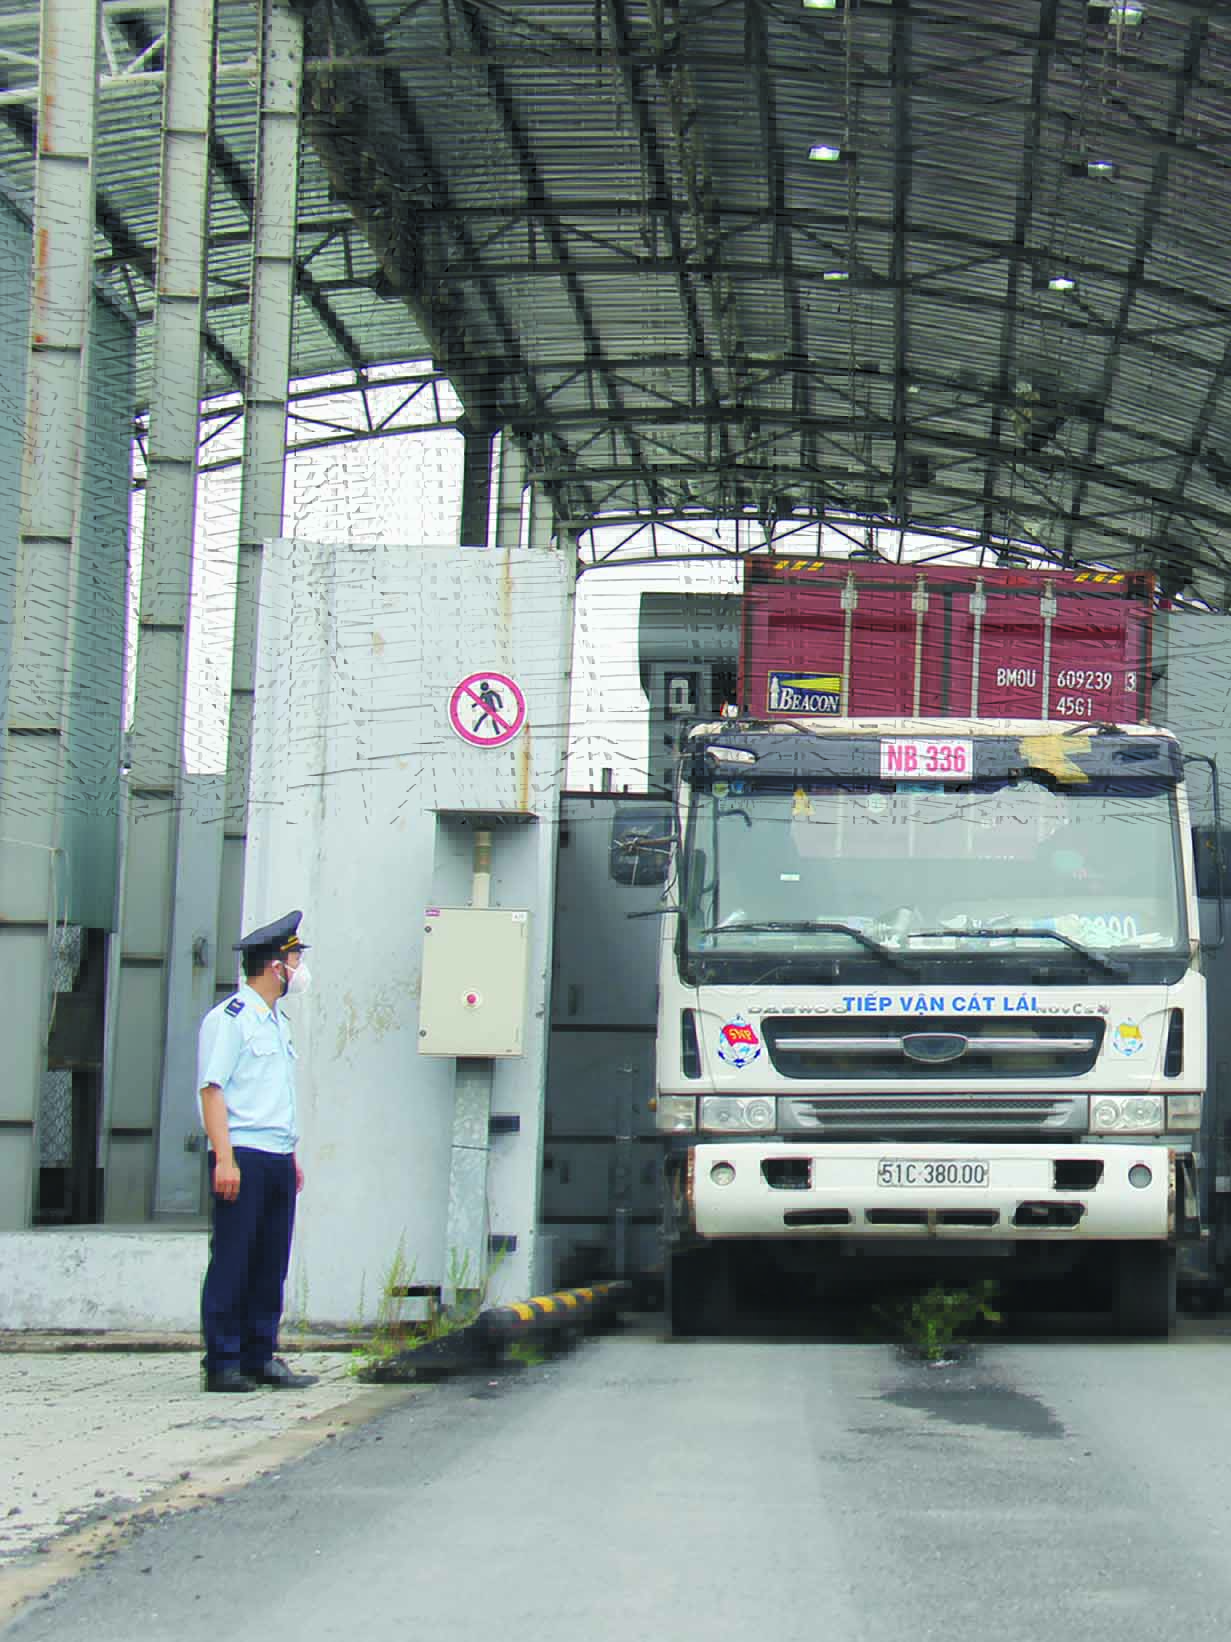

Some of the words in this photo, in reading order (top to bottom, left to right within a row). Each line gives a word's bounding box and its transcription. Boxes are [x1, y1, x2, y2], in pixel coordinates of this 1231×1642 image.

[996, 668, 1036, 687] BMOU
[1056, 671, 1113, 689] 609239
[1125, 671, 1137, 692] 3
[779, 687, 840, 712] BEACON
[1056, 696, 1093, 716] 45G1
[887, 745, 918, 772] NB
[926, 745, 966, 772] 336
[842, 991, 893, 1012] TIẾP
[900, 993, 945, 1015] VẬN
[952, 992, 996, 1012] CÁT
[1003, 992, 1038, 1012] LÁI
[881, 1164, 916, 1184] 51C
[924, 1164, 985, 1184] 380.00
